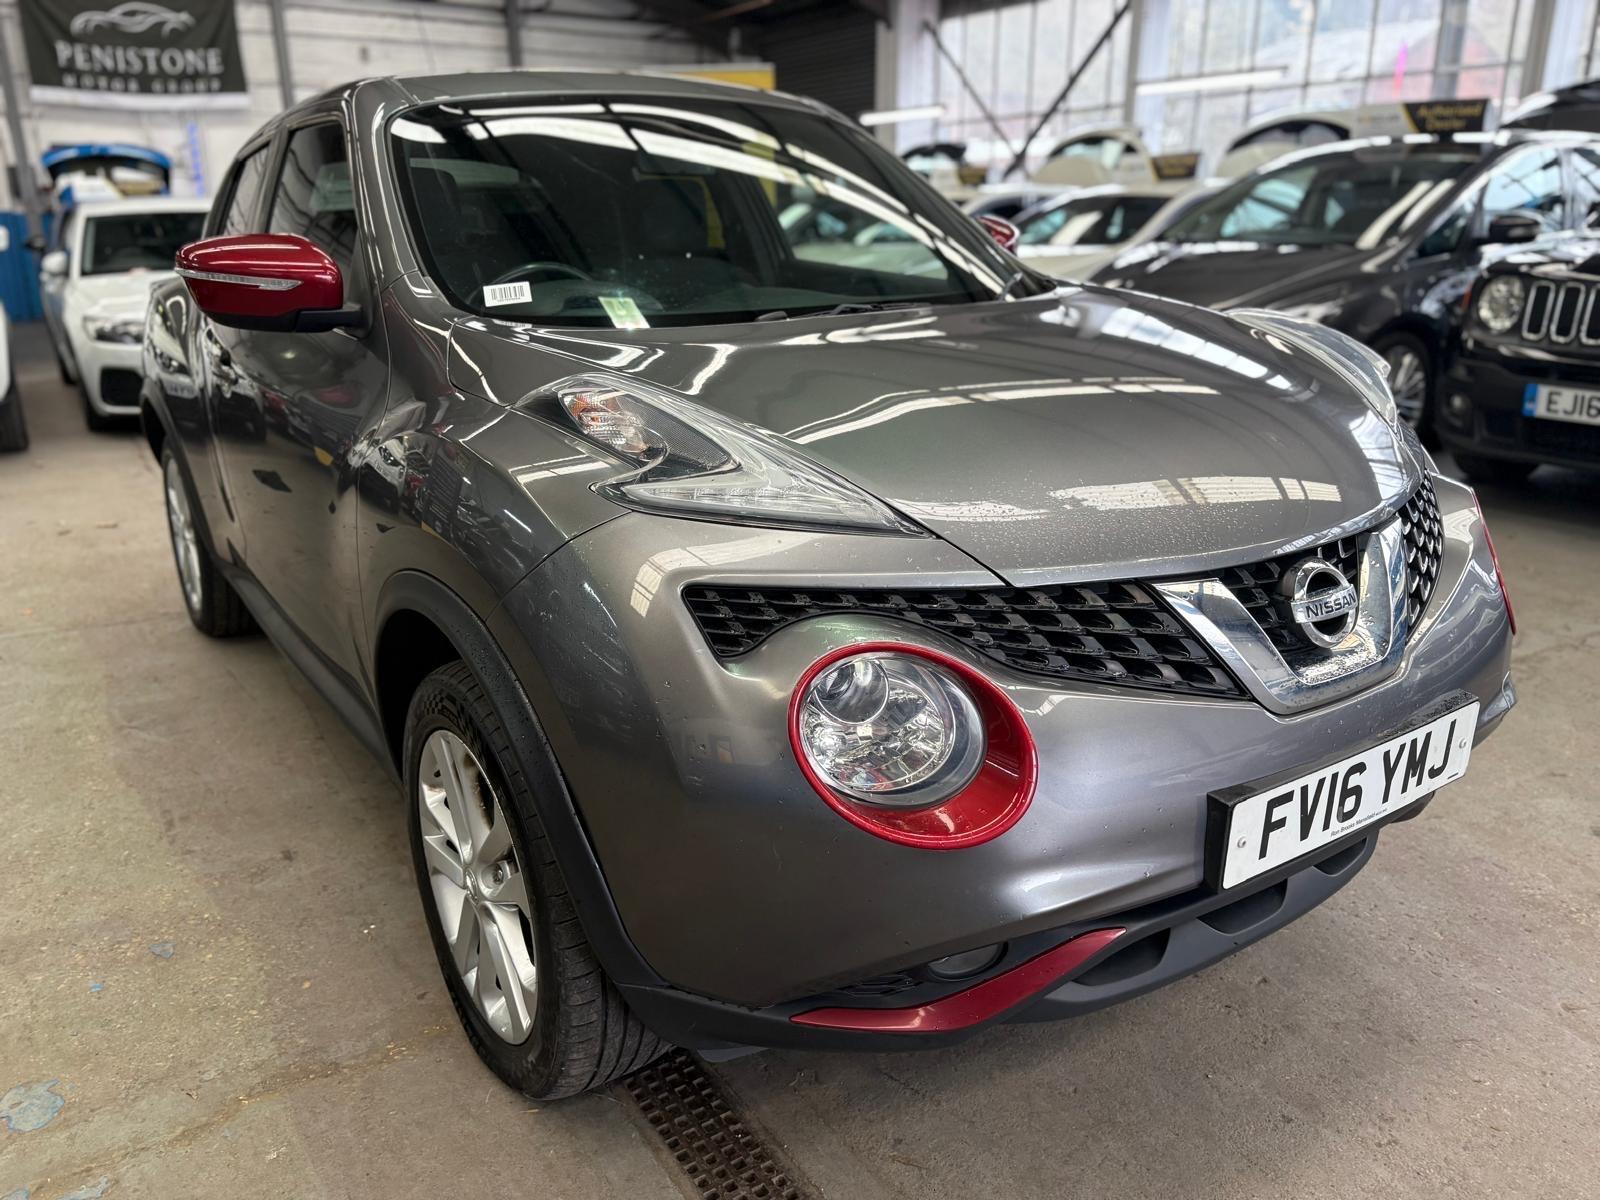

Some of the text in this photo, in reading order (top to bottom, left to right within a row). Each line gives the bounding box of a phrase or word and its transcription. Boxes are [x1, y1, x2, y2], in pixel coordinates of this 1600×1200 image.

[54, 39, 225, 75] PENISTONE
[1546, 390, 1600, 418] EJ16
[1305, 592, 1357, 618] NISSAN
[1258, 719, 1457, 860] FV16 YMJ
